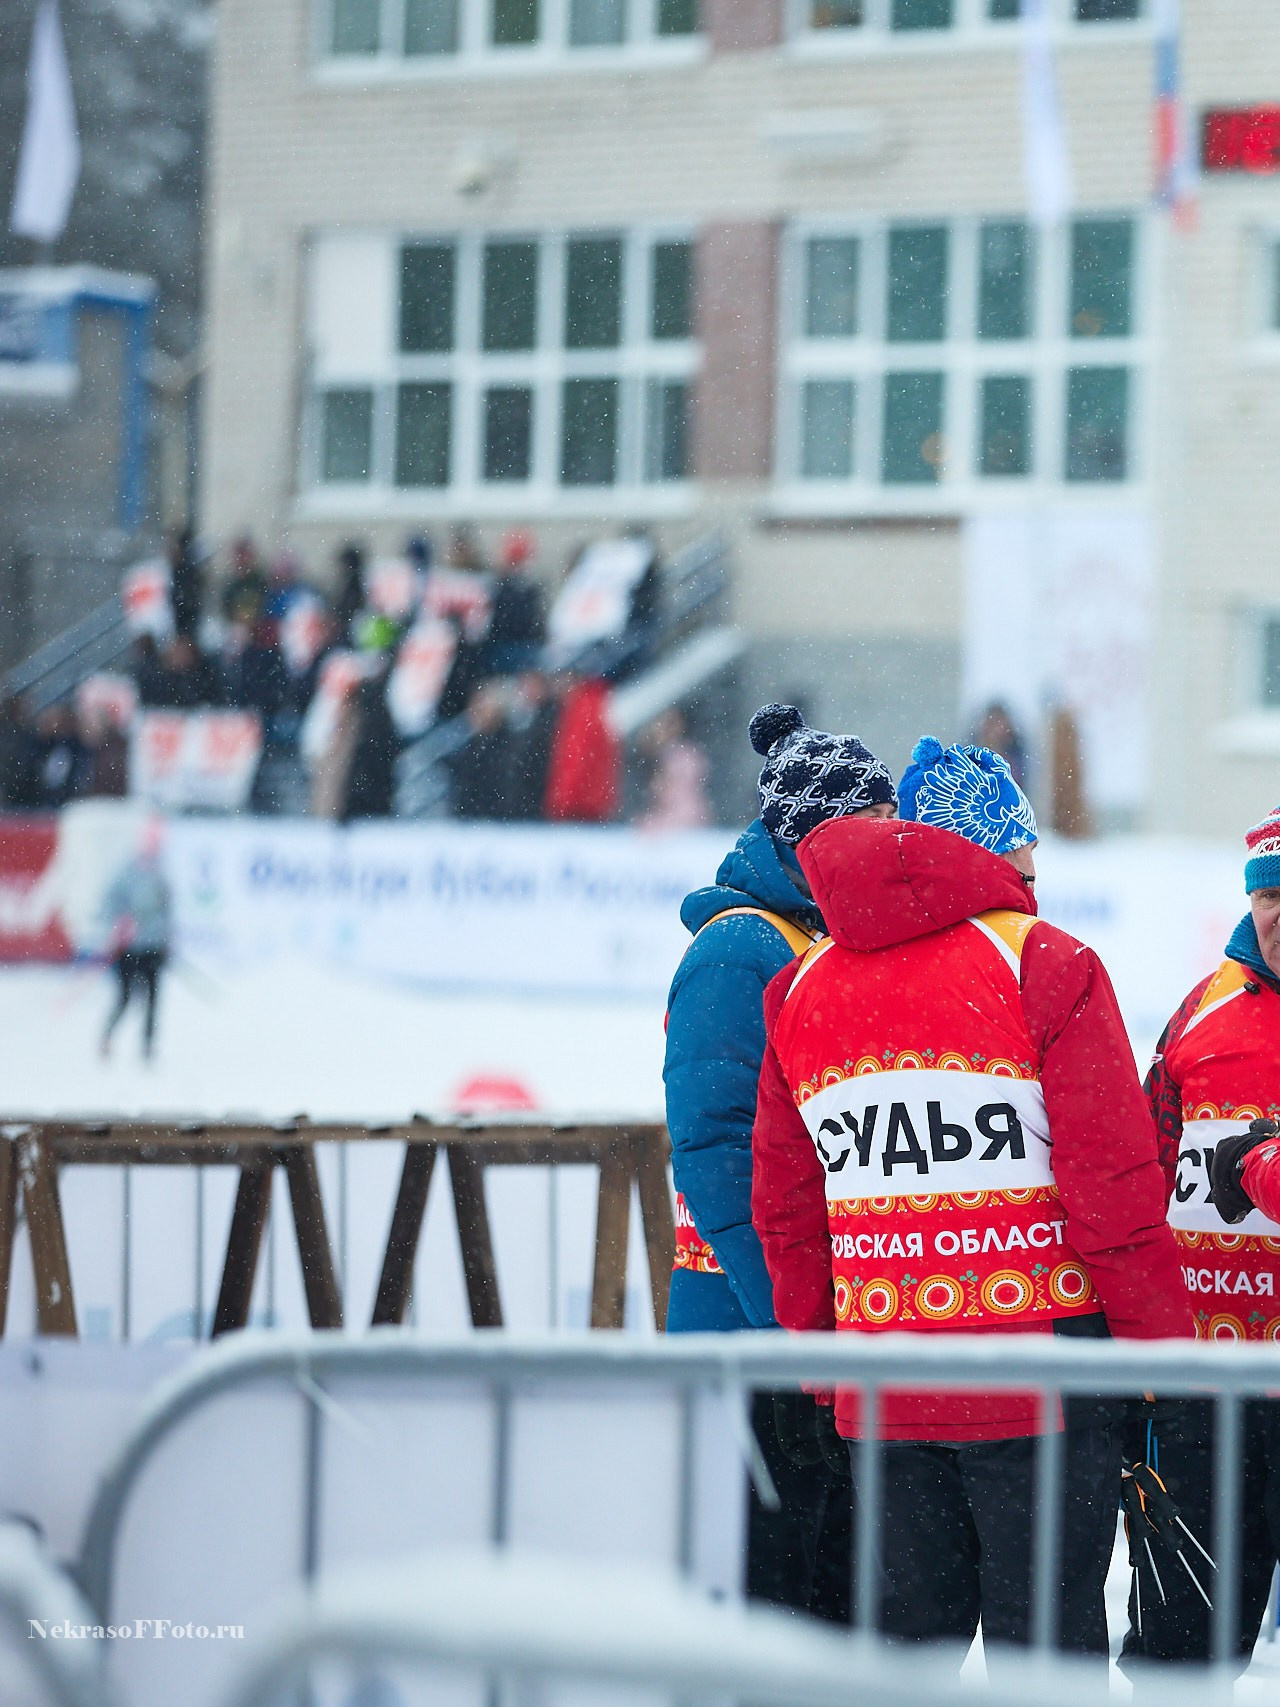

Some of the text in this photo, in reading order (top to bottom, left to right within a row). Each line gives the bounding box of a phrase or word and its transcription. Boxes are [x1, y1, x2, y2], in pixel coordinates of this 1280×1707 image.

[817, 1100, 1027, 1177] СУДЬЯ
[934, 1219, 1068, 1257] ОБЛАСТ
[1180, 1265, 1274, 1297] ВСКАЯ
